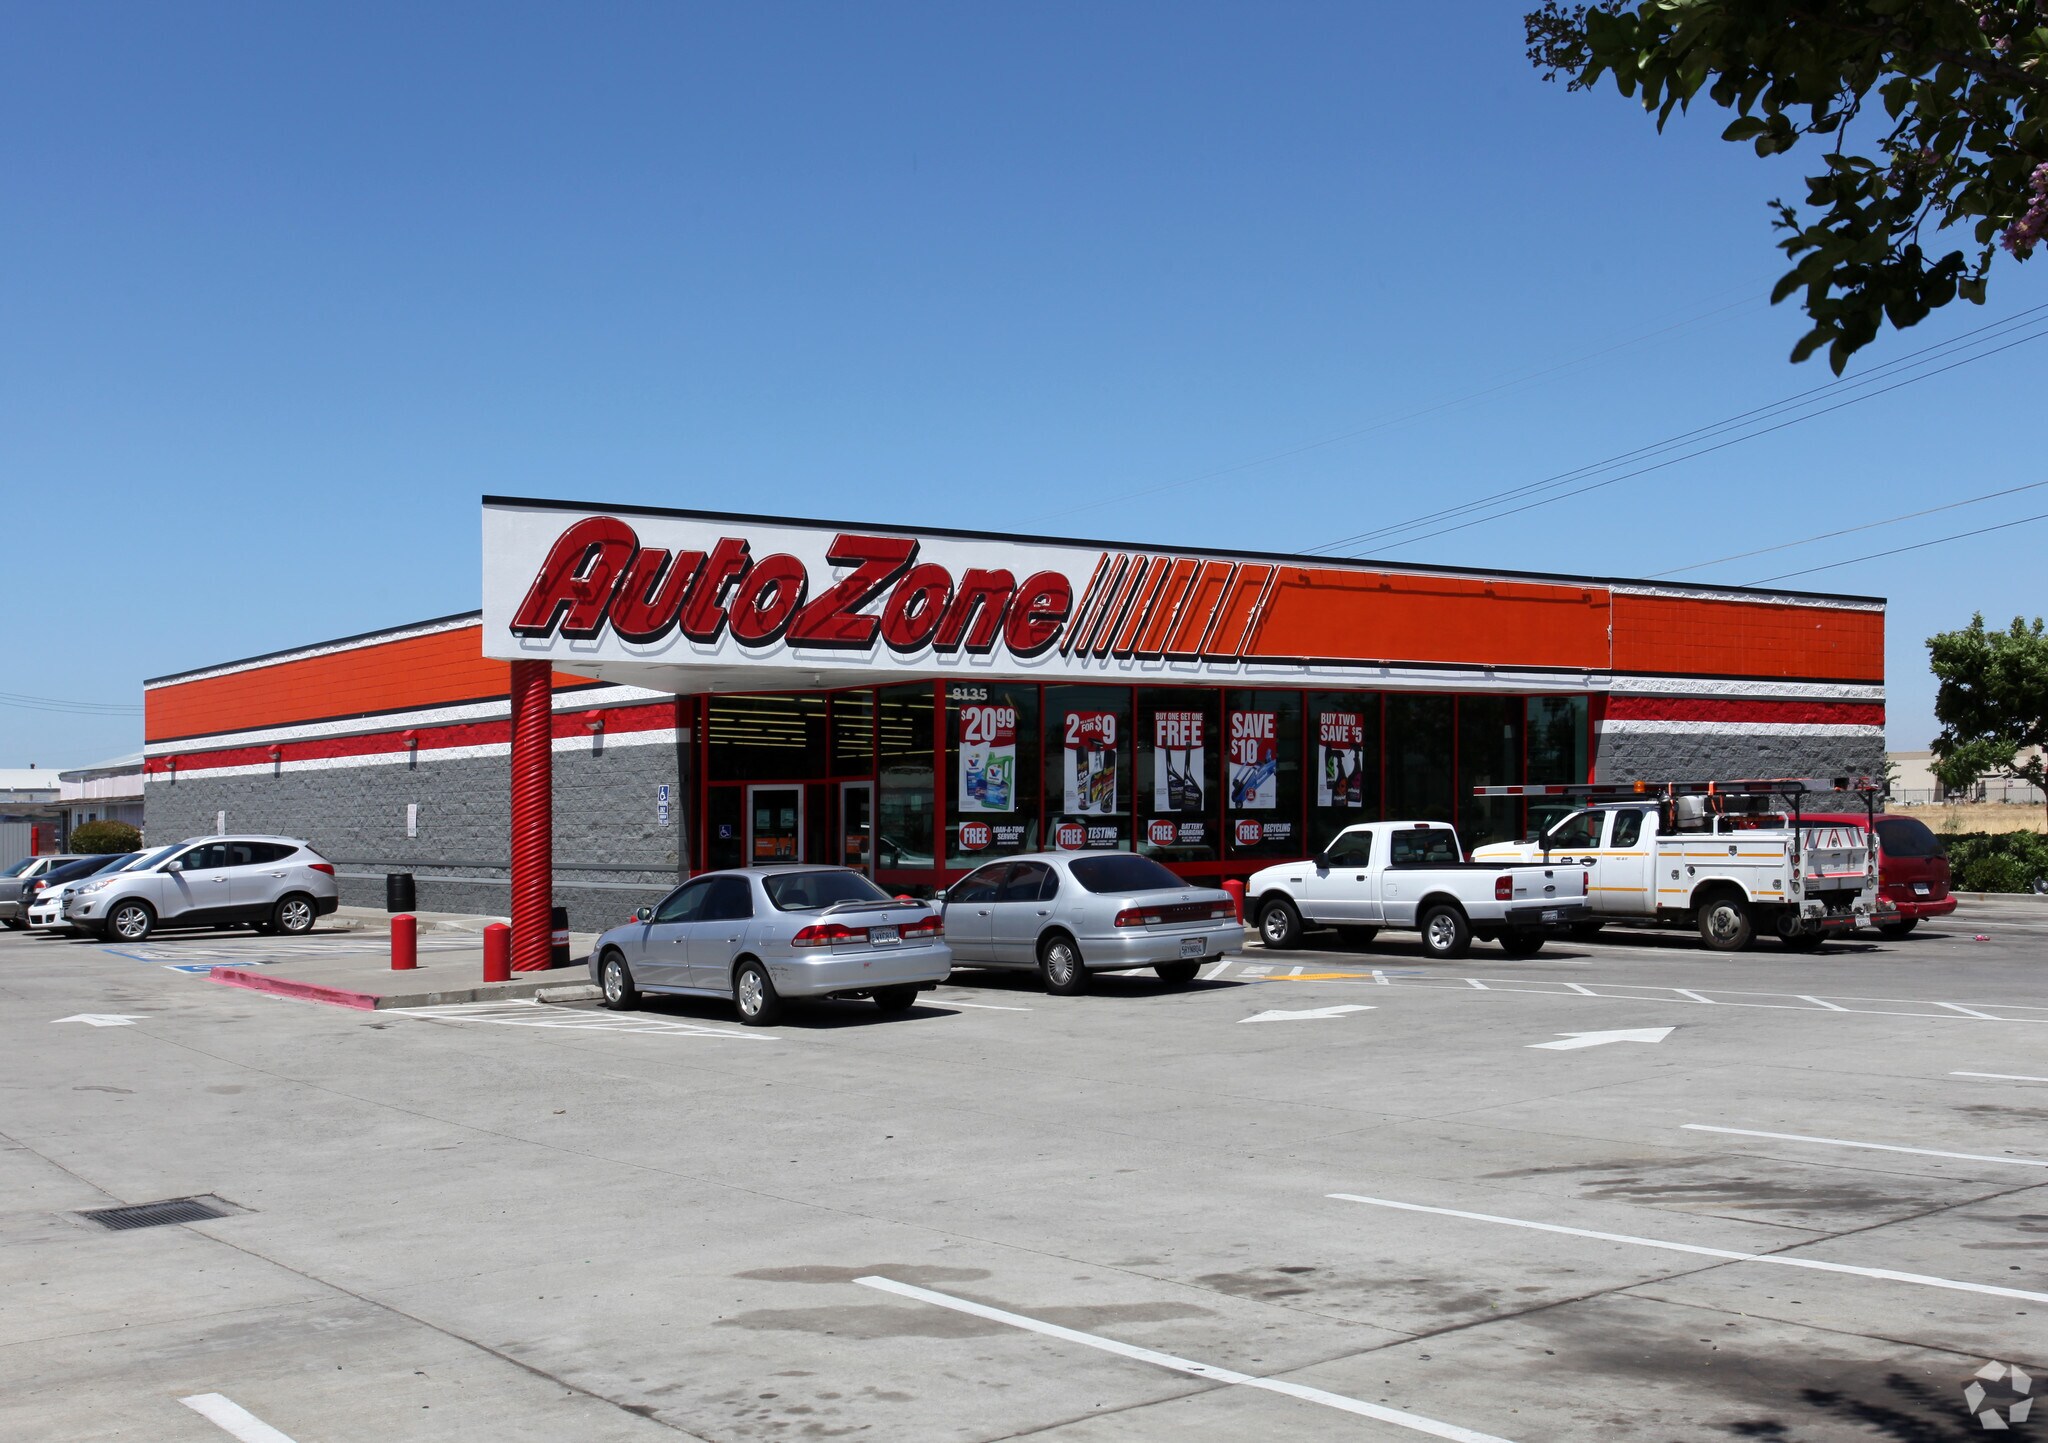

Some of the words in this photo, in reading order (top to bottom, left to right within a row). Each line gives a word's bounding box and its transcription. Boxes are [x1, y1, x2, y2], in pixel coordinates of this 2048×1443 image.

[510, 515, 1073, 659] AutoZone
[952, 688, 988, 701] 8135
[1155, 712, 1167, 720] BUY
[1167, 712, 1179, 720] ONE
[1180, 712, 1191, 720] GET
[1191, 712, 1203, 721] ONE
[1320, 712, 1337, 724] BUY
[1338, 713, 1356, 725] TWO
[1065, 713, 1080, 744] 2
[1081, 722, 1094, 733] FOR
[1095, 714, 1116, 745] $9
[1156, 720, 1202, 746] FREE
[1231, 712, 1274, 738] SAVE
[1320, 725, 1349, 742] SAVE
[1351, 726, 1363, 743] $5
[1231, 739, 1258, 764] $10
[992, 825, 1025, 833] LOAN-A-TOOL
[1087, 826, 1118, 839] TESTING
[1152, 825, 1173, 841] FREE
[1181, 822, 1204, 830] BATTERY
[1239, 824, 1259, 840] FREE
[1263, 822, 1291, 833] RECYCLING
[963, 827, 988, 844] FREE
[997, 832, 1019, 840] SERVICE
[1060, 828, 1083, 845] FREE
